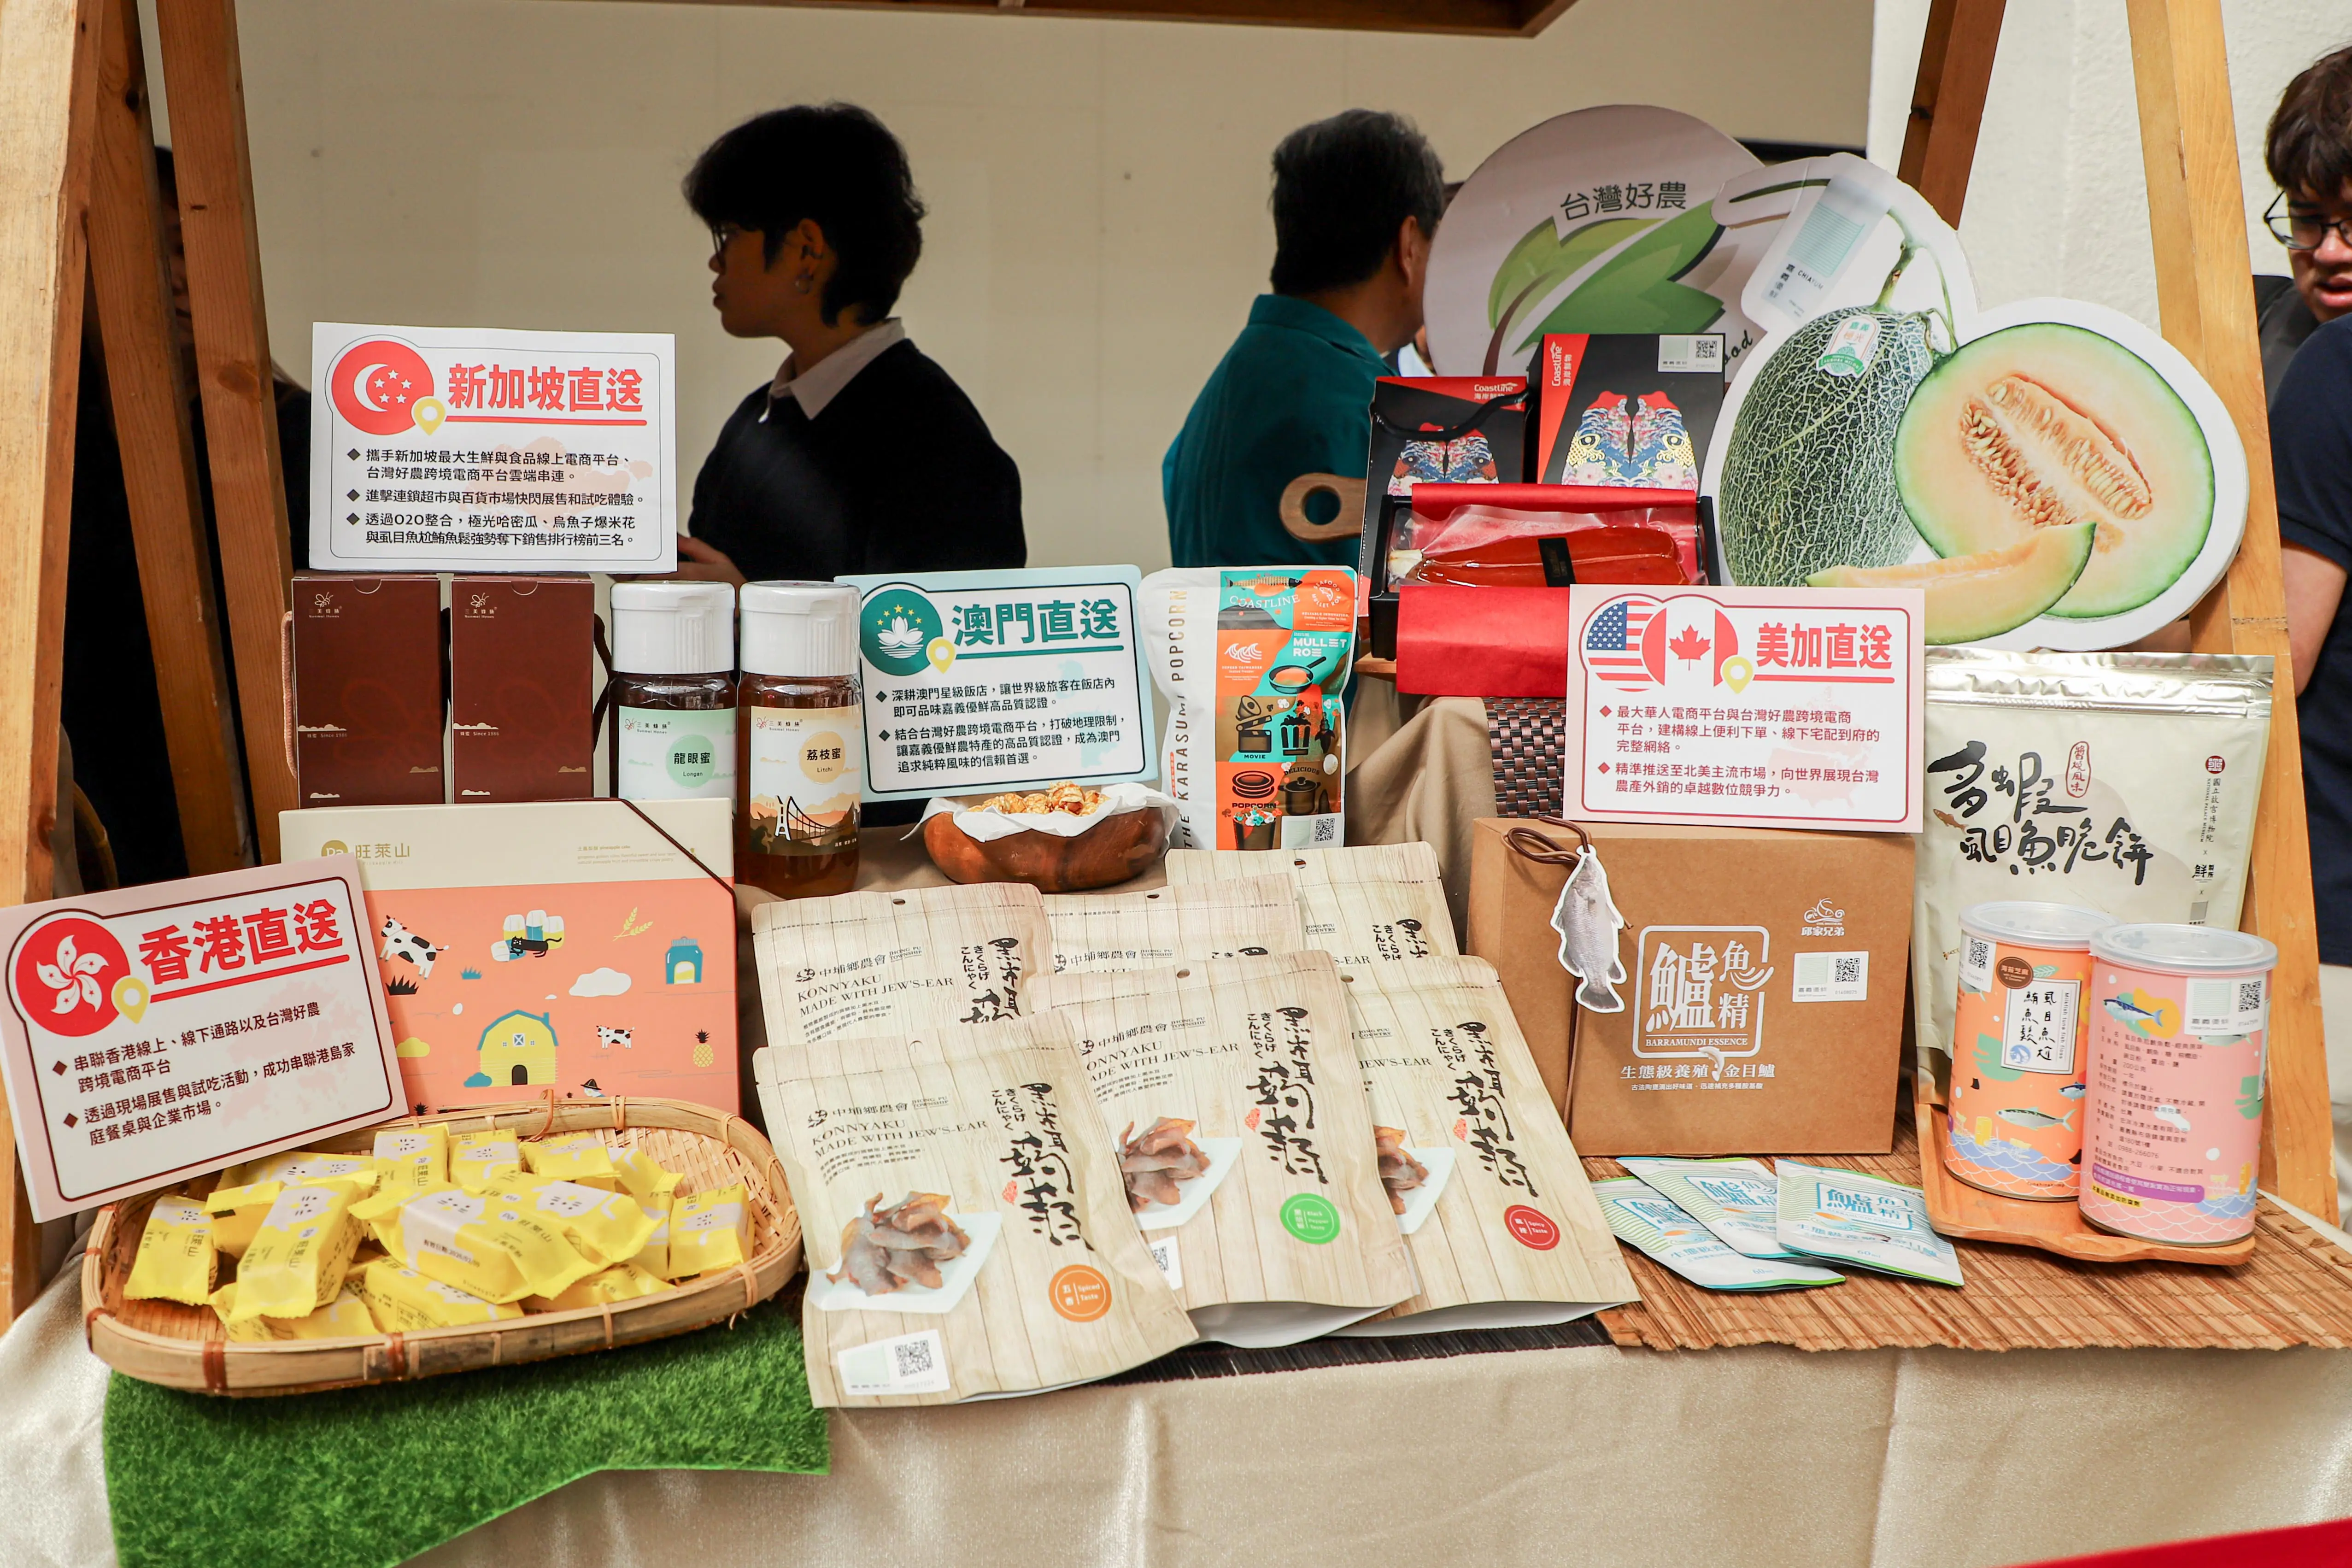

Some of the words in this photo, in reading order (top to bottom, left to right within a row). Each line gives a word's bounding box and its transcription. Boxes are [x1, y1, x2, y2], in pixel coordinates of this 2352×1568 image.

[1560, 182, 1686, 220] 台灣好農
[1552, 345, 1562, 387] Coastline
[448, 363, 643, 413] 新加坡直送
[1474, 383, 1513, 392] Coastline
[367, 467, 575, 483] 台灣好農跨境電商平台雲端串連。
[1230, 594, 1301, 608] COASTLINE
[1311, 593, 1330, 608] MULLET
[1313, 579, 1340, 592] SEAFOOD
[951, 599, 1120, 646] 澳門直送
[1169, 590, 1188, 681] POPCORN
[1293, 637, 1347, 648] MULLET
[1293, 648, 1322, 657] ROE
[1756, 622, 1893, 669] 美加直送
[893, 697, 1057, 717] 即可品味嘉義優鮮高品質認證。
[1617, 705, 1851, 724] 最大華人電商平台與台灣好農跨境電商
[674, 752, 710, 764] 龍眼蜜
[807, 748, 841, 761] 荔枝蜜
[898, 753, 1038, 773] 追求純粹風味的信賴首選。
[1175, 694, 1189, 801] KARASUMI
[1616, 740, 1681, 754] 完整網絡。
[1285, 767, 1320, 775] DELICIOUS
[1927, 740, 2088, 823] 多蝦
[1615, 779, 1791, 798] 農產外銷的卓越數位競爭力。
[2205, 778, 2221, 843] 國立故宮博物院
[1180, 815, 1190, 848] THE
[355, 843, 410, 859] 旺萊山
[1960, 817, 2154, 886] 虱目魚脆餅
[138, 899, 343, 986] 香港直送
[1372, 925, 1390, 961] こんにゃ
[1801, 926, 1845, 936] 邱家兄弟
[820, 954, 886, 977] 中埔鄉農會
[960, 946, 978, 990] こんにゃく
[974, 945, 990, 980] きくらげ
[1070, 951, 1137, 967] 中埔鄉農會
[798, 974, 882, 1003] KONNYAKU
[799, 996, 837, 1017] MADE
[841, 987, 878, 1002] WITH
[882, 976, 954, 994] JEW'S-EAR
[1645, 940, 1774, 1032] 鱸魚精
[1261, 1012, 1277, 1052] きくらげ
[2019, 991, 2039, 1045] 鮪魚鬆
[2036, 991, 2057, 1061] 虱目魚尬
[1098, 1023, 1167, 1048] 中埔鄉農會
[1246, 1013, 1263, 1059] こんにゃく
[1430, 1028, 1456, 1071] こんにゃく
[1443, 1028, 1466, 1063] きくらげ
[1645, 1038, 1707, 1047] BARRAMUNDI
[1708, 1038, 1748, 1046] ESSENCE
[1086, 1040, 1163, 1071] ONNYAKU
[1090, 1067, 1117, 1082] ADE
[1120, 1057, 1159, 1071] WITH
[1162, 1043, 1239, 1063] JEW'S-EAR
[1359, 1057, 1431, 1069] JEW'S-EAR
[1620, 1064, 1709, 1080] 生態級養殖
[1724, 1063, 1776, 1078] 金目鱸
[79, 1059, 171, 1093] 跨境電商平台
[833, 1102, 908, 1117] 中埔鄉農會
[991, 1089, 1014, 1131] こんにゃく
[1005, 1088, 1026, 1122] きくらげ
[89, 1100, 222, 1145] 庭餐桌與企業市場。
[812, 1120, 906, 1146] KONNYAKU
[815, 1134, 858, 1158] MADE
[862, 1132, 903, 1143] WITH
[908, 1120, 989, 1139] JEW'S-EAR
[1078, 1283, 1100, 1292] Spiced
[1079, 1293, 1099, 1301] Taste
